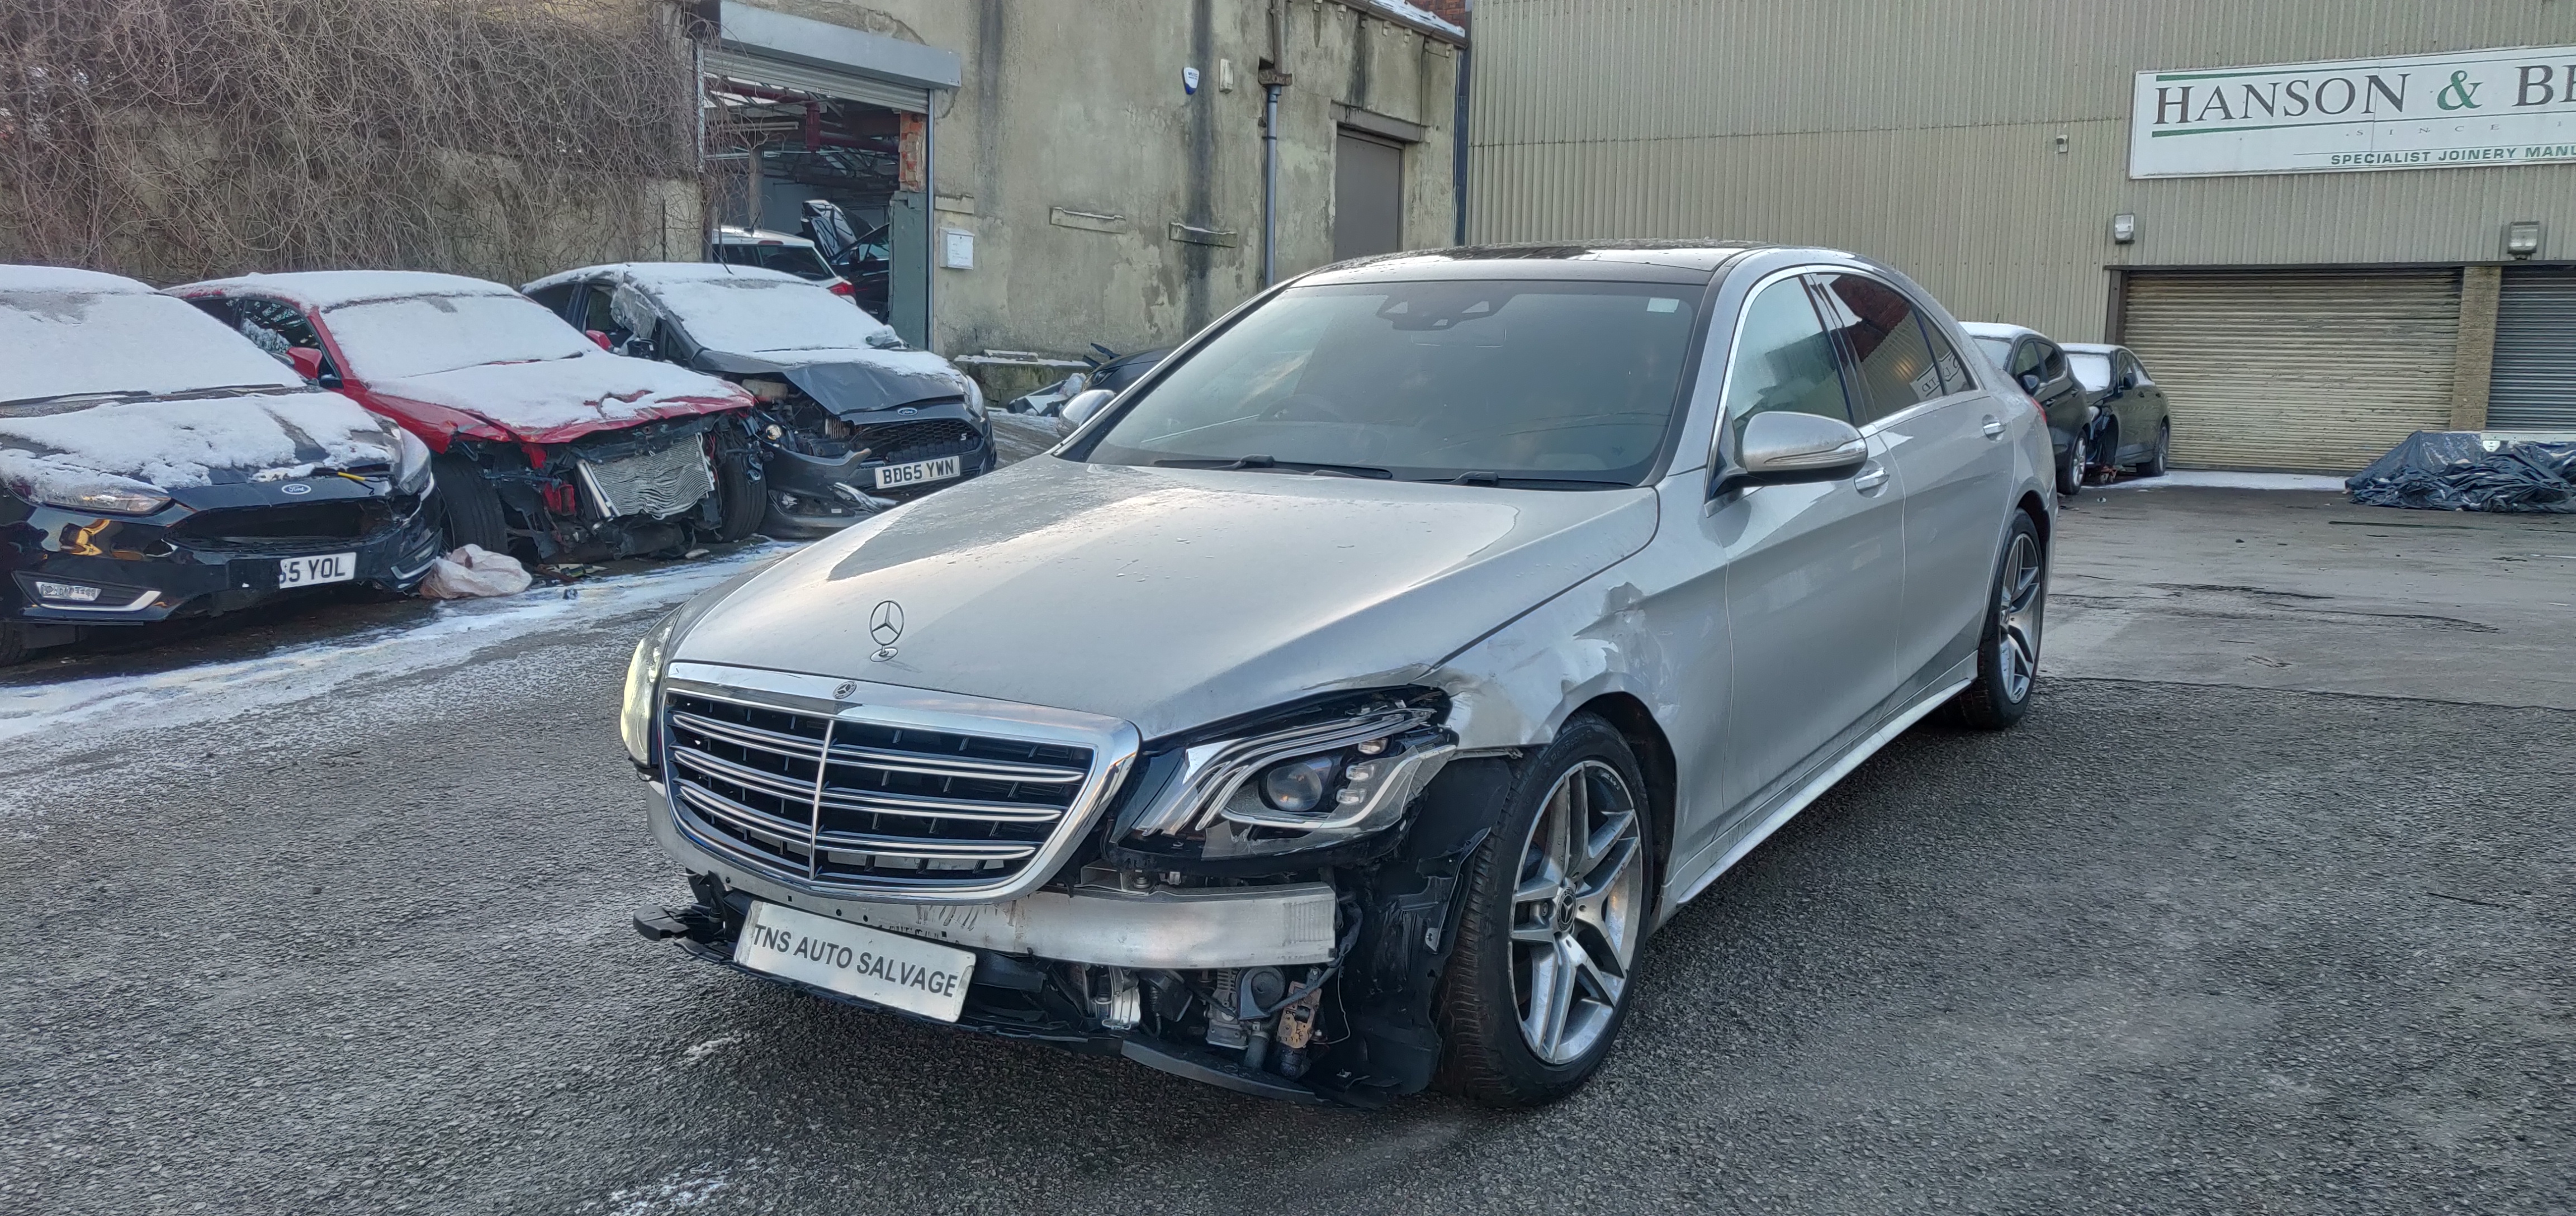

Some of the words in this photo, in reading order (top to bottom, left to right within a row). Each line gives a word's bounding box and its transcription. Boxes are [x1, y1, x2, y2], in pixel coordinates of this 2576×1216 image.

[2153, 73, 2411, 125] HANSON
[2437, 70, 2484, 111] &
[2356, 124, 2500, 136] SINCE
[2331, 151, 2431, 165] SPECIALIST
[2438, 147, 2518, 162] JOINERY
[883, 463, 923, 484] BD65
[926, 458, 955, 478] YWN
[308, 557, 345, 580] YOL
[752, 924, 792, 953] TNS
[793, 936, 853, 969] AUTO
[856, 952, 959, 998] SALVAGE
